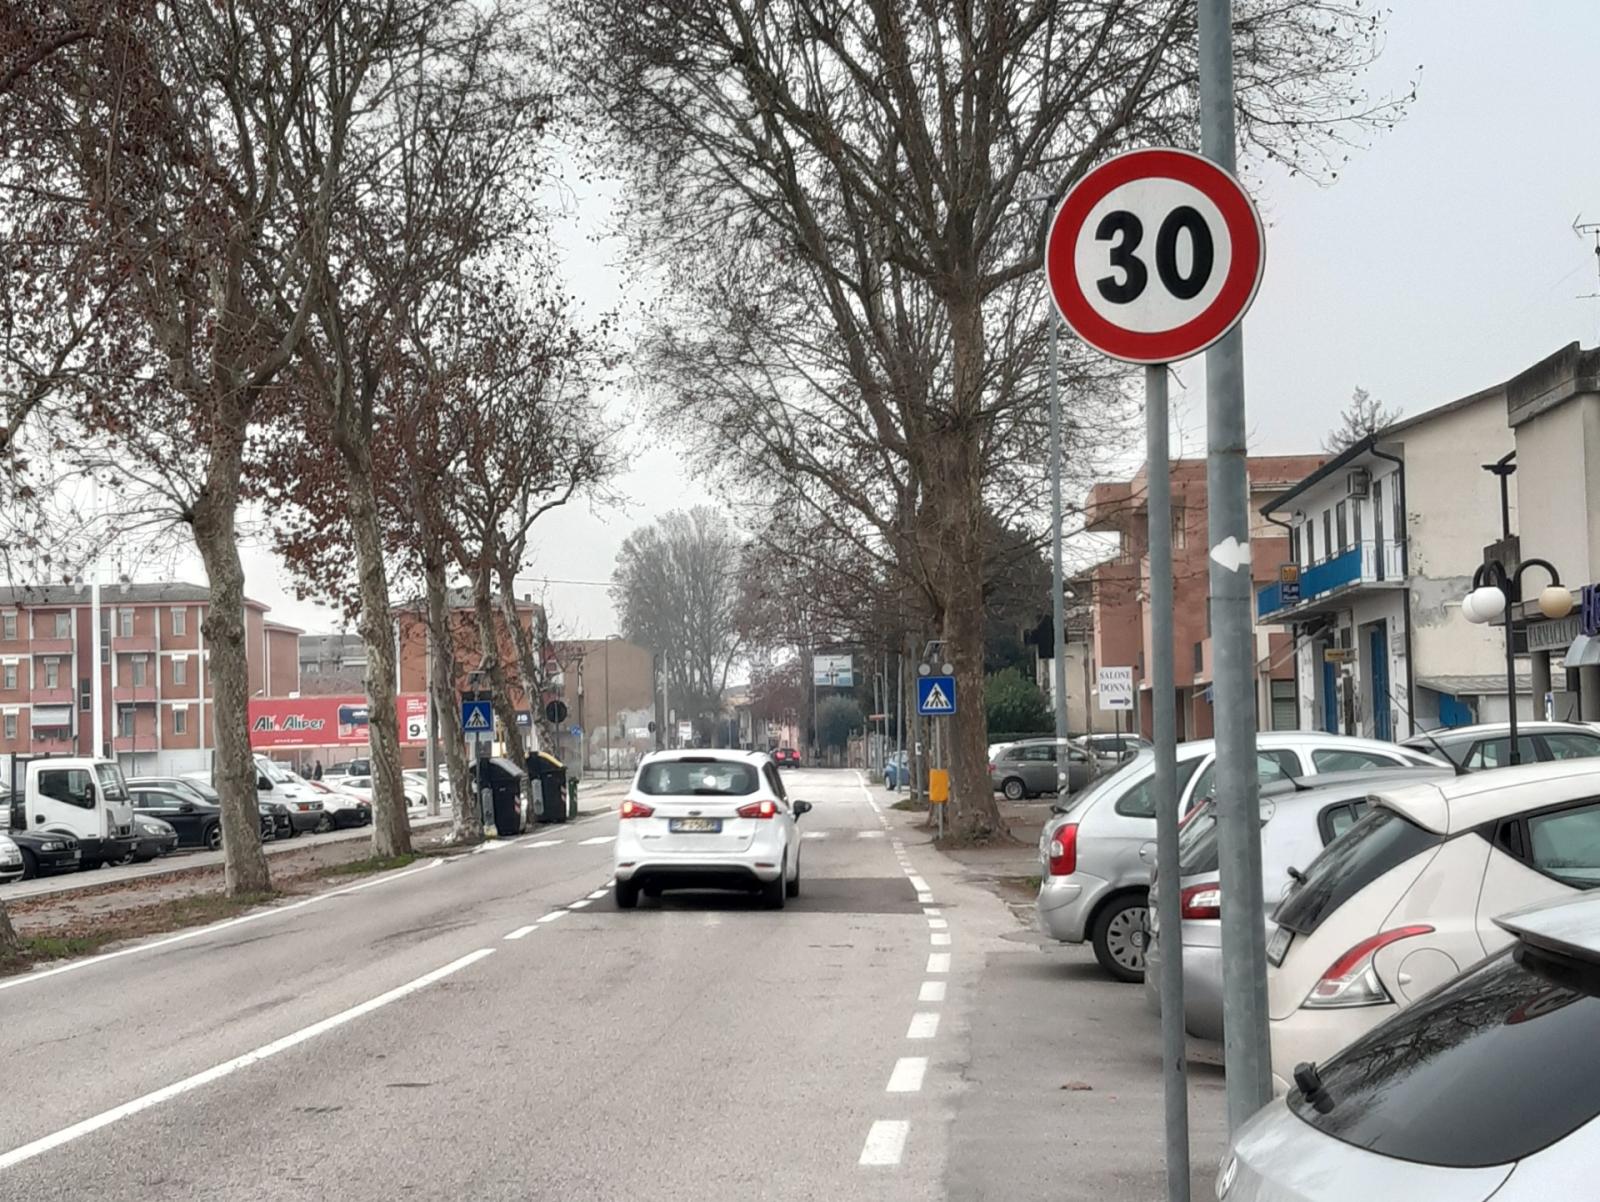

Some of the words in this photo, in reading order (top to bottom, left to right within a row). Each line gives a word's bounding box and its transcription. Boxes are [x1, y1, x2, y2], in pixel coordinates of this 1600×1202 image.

[1094, 205, 1214, 304] 30
[1100, 671, 1130, 680] SALONE
[1100, 682, 1132, 692] DONNA
